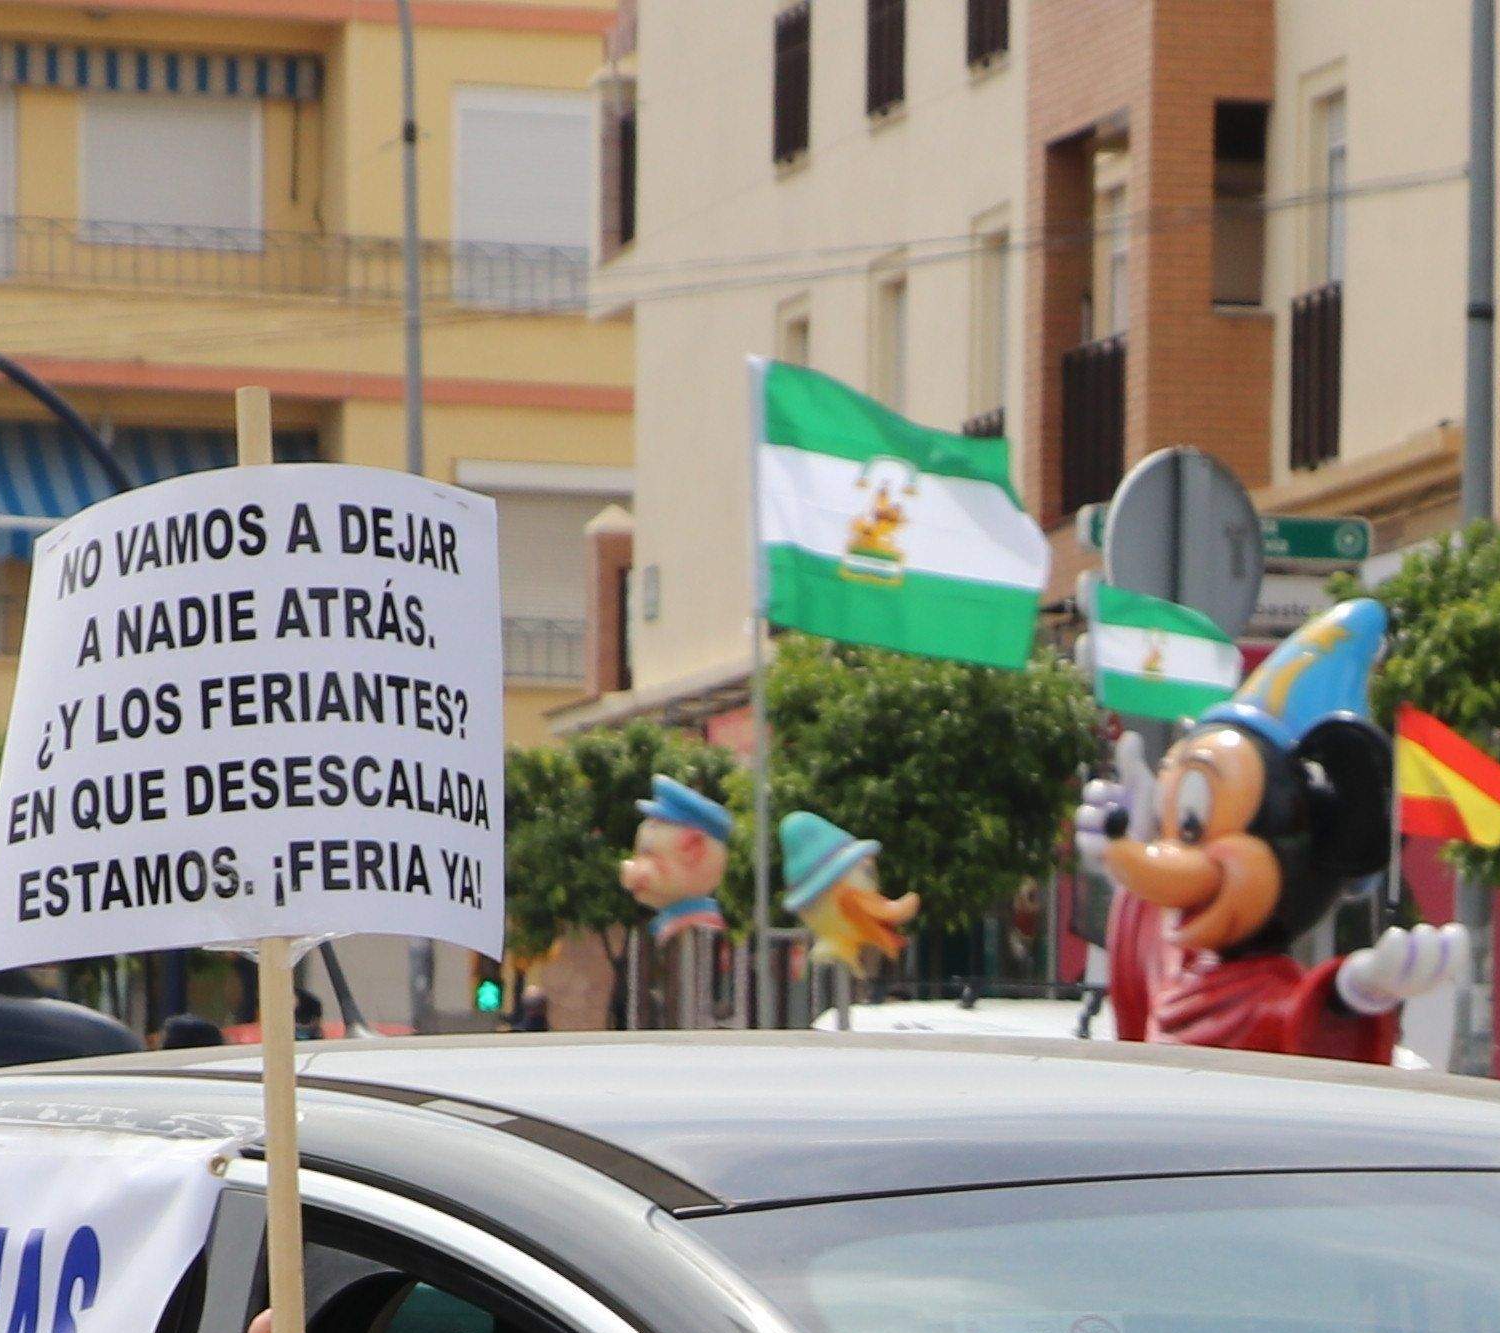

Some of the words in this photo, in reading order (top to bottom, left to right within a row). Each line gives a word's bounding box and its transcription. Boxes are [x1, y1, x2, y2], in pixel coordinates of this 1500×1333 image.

[57, 539, 102, 599] NO
[114, 504, 267, 577] VAMOS
[286, 502, 321, 553] A
[339, 504, 463, 575] DEJAR
[77, 617, 102, 668] A
[116, 590, 257, 659] NADIE
[276, 580, 436, 649] ATRÁS.
[37, 699, 82, 772] ¿Y
[95, 682, 183, 745] LOS
[200, 671, 469, 740] FERIANTES?
[7, 785, 56, 845] EN
[70, 769, 167, 832] QUE
[185, 754, 491, 832] DESESCALADA
[18, 844, 255, 923] ESTAMOS.
[272, 838, 432, 908] ¡FERIA
[439, 848, 483, 909] YA!
